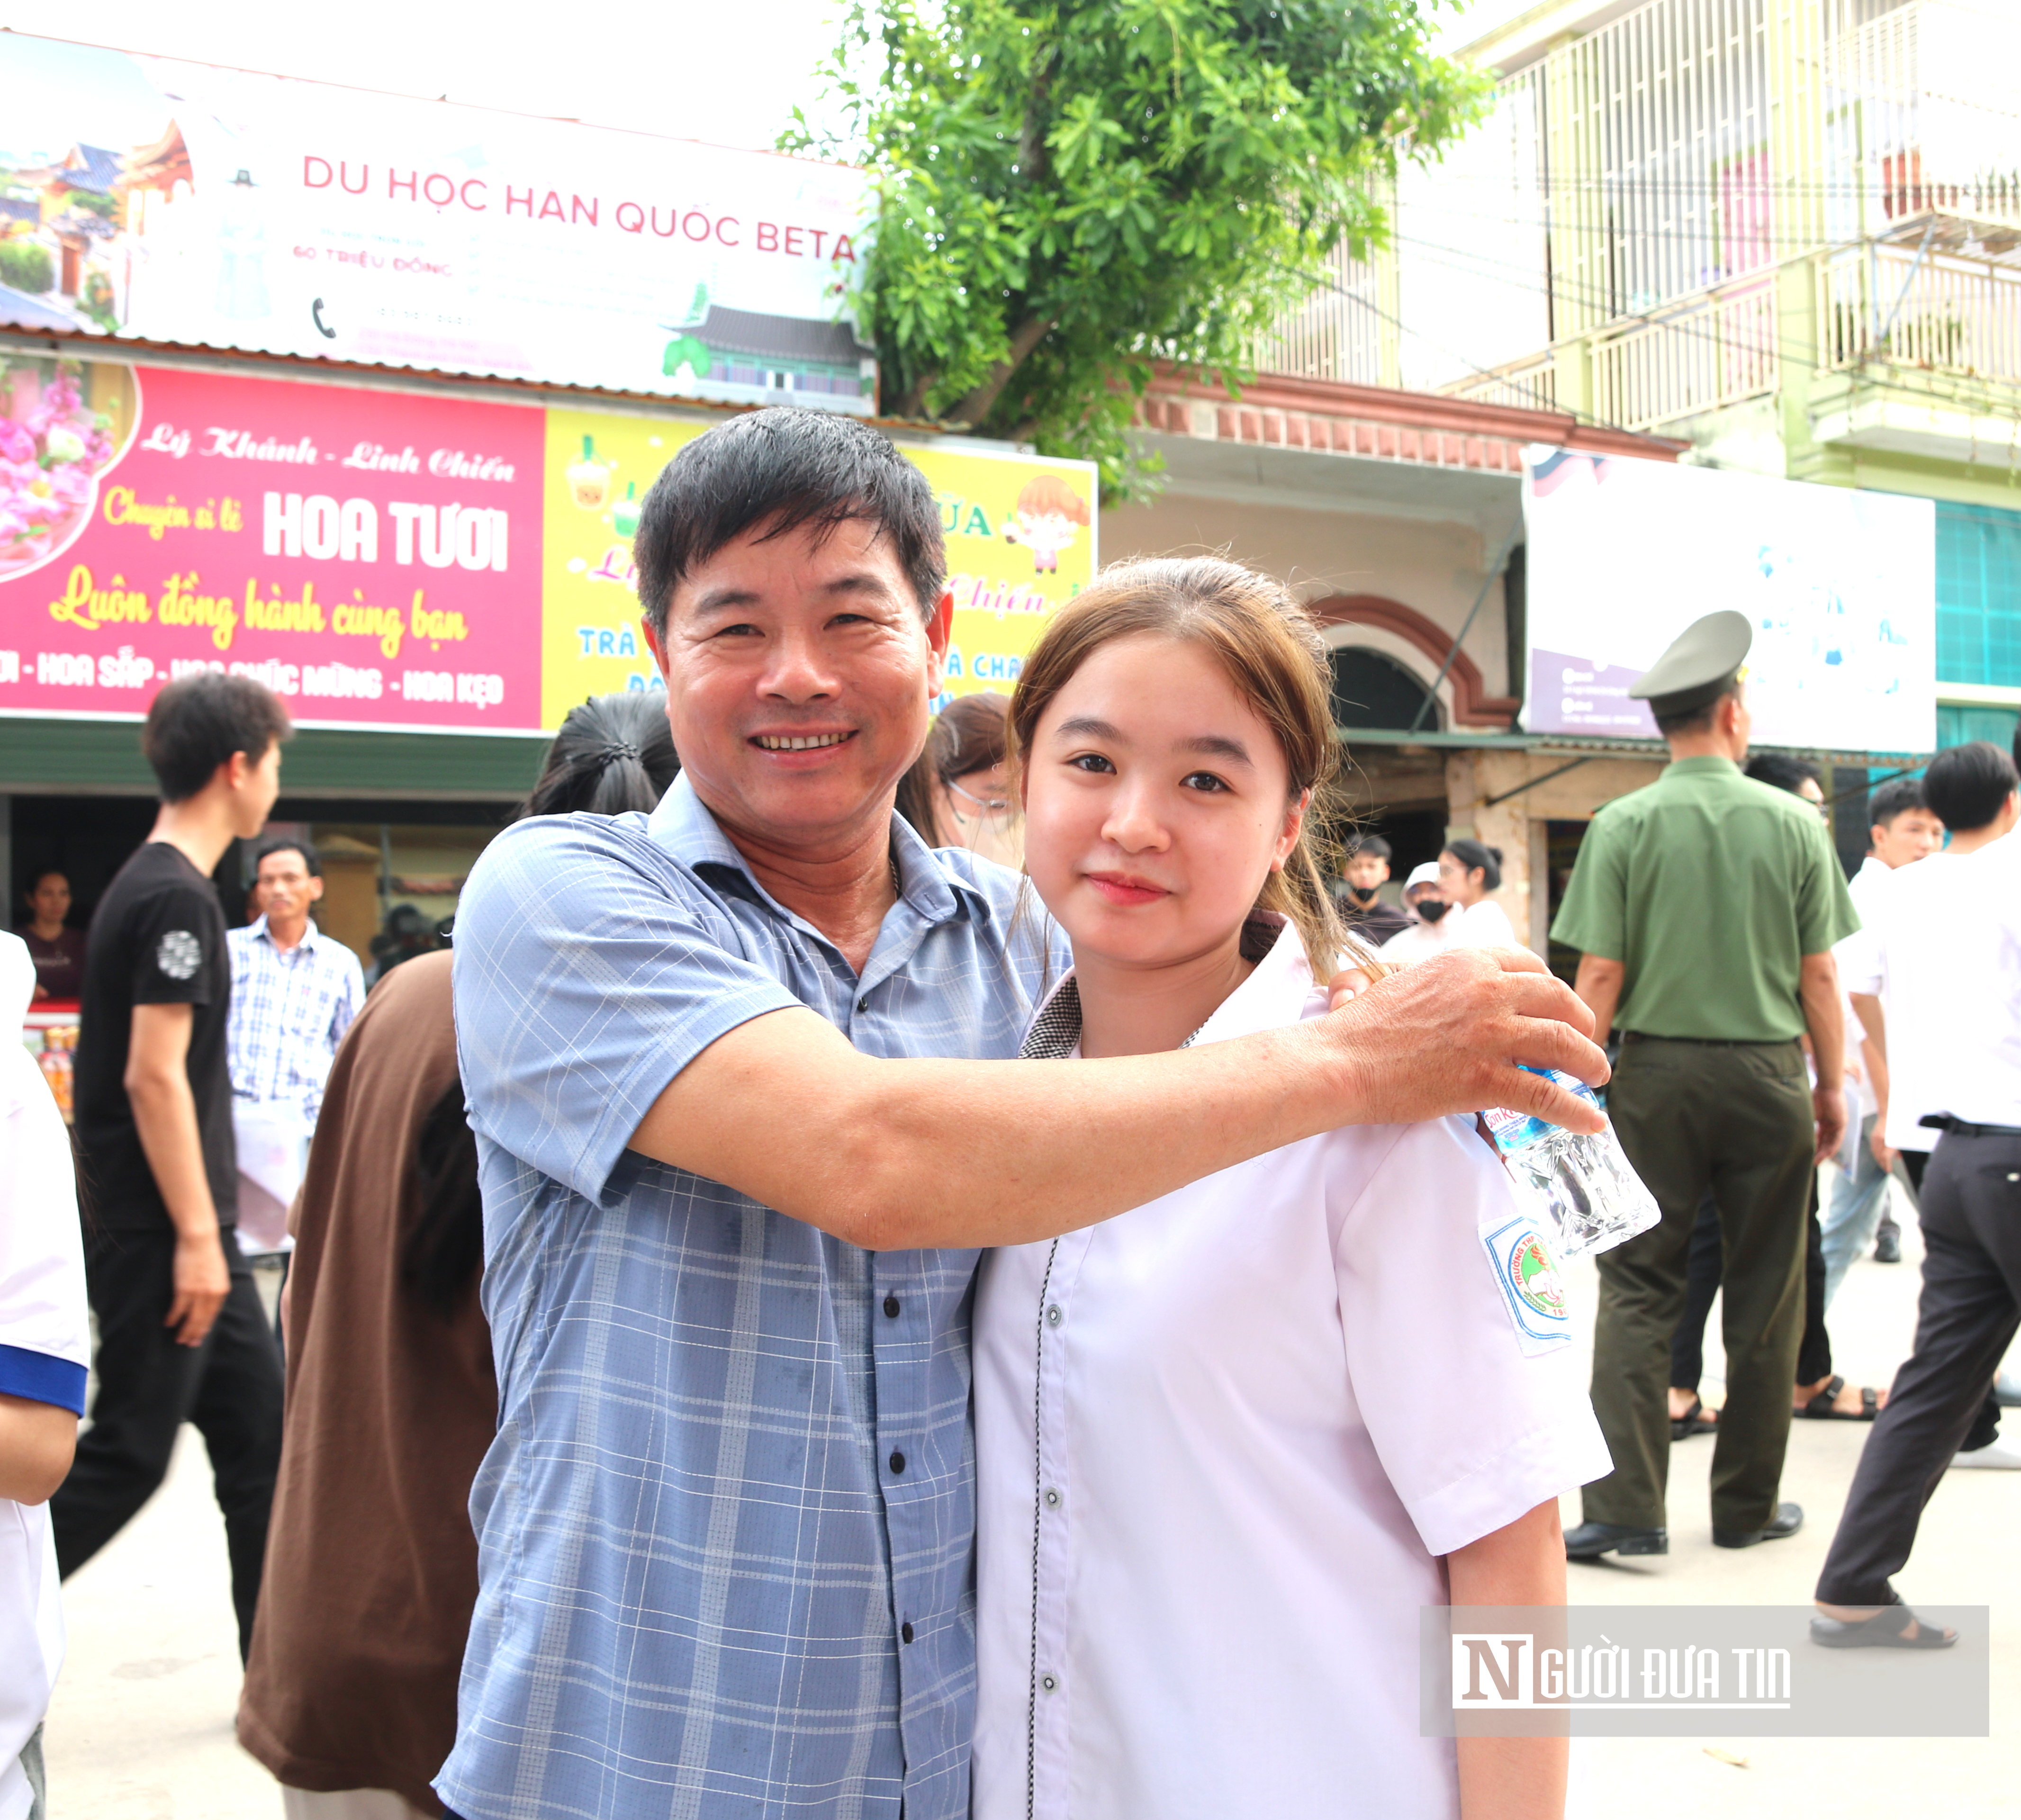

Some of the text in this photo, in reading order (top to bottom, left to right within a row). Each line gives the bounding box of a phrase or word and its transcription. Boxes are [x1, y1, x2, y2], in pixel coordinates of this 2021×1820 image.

[303, 155, 369, 195] DU
[388, 167, 488, 214] HỌC
[756, 221, 856, 262] BETA
[139, 423, 192, 459] Lý
[341, 441, 422, 474] Linh
[262, 491, 509, 572] HOA TƯƠI
[48, 564, 469, 659] Luôn đồng hành cùng bạn
[37, 652, 95, 686] HOA
[403, 669, 454, 702] HOA
[578, 622, 635, 656] TRÀ
[974, 655, 1021, 679] CHA
[1511, 1247, 1524, 1286] TRƯỜNG
